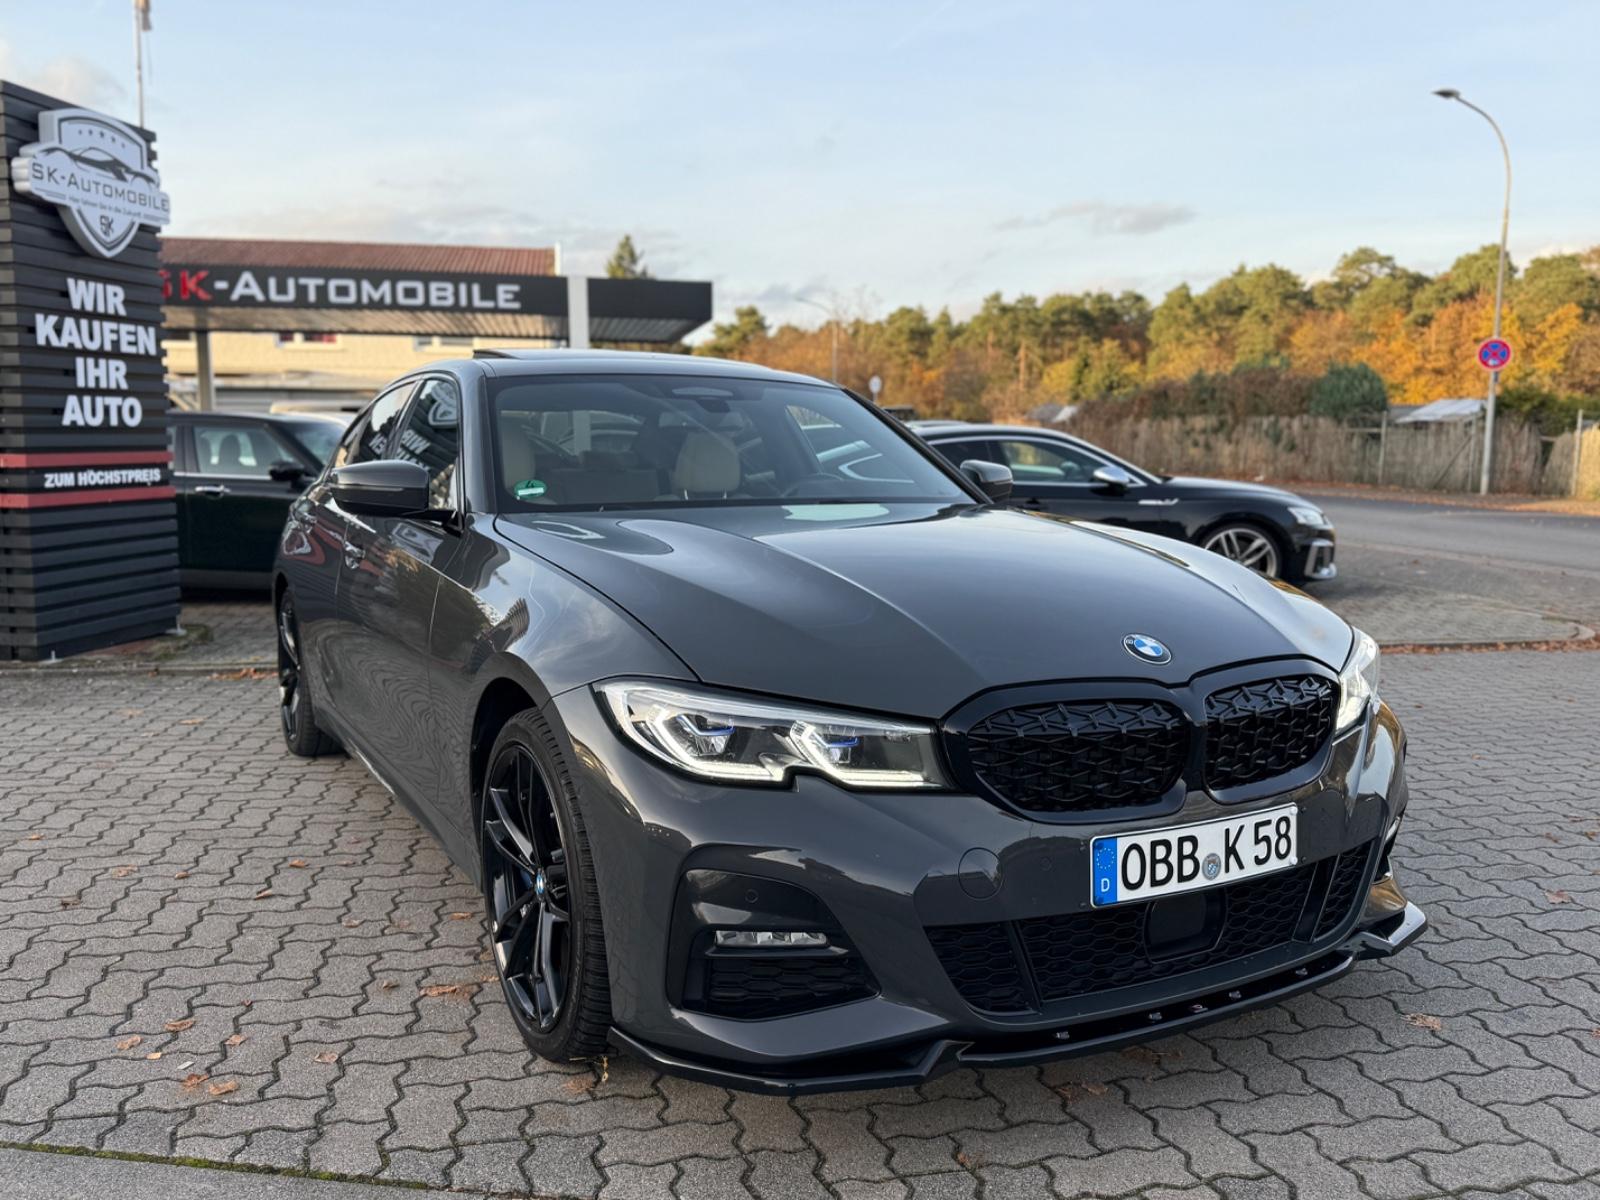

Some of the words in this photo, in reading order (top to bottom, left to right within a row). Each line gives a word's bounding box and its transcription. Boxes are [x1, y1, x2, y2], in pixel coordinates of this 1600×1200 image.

[66, 277, 127, 316] WIR
[35, 313, 157, 356] KAUFEN
[75, 357, 129, 390] IHR
[61, 395, 142, 427] AUTO
[44, 472, 75, 488] ZUM
[78, 468, 161, 486] HÖCHSTPREIS
[1101, 878, 1110, 893] D
[1121, 835, 1200, 891] OBB
[1224, 824, 1245, 874] K
[1254, 816, 1292, 866] 58
